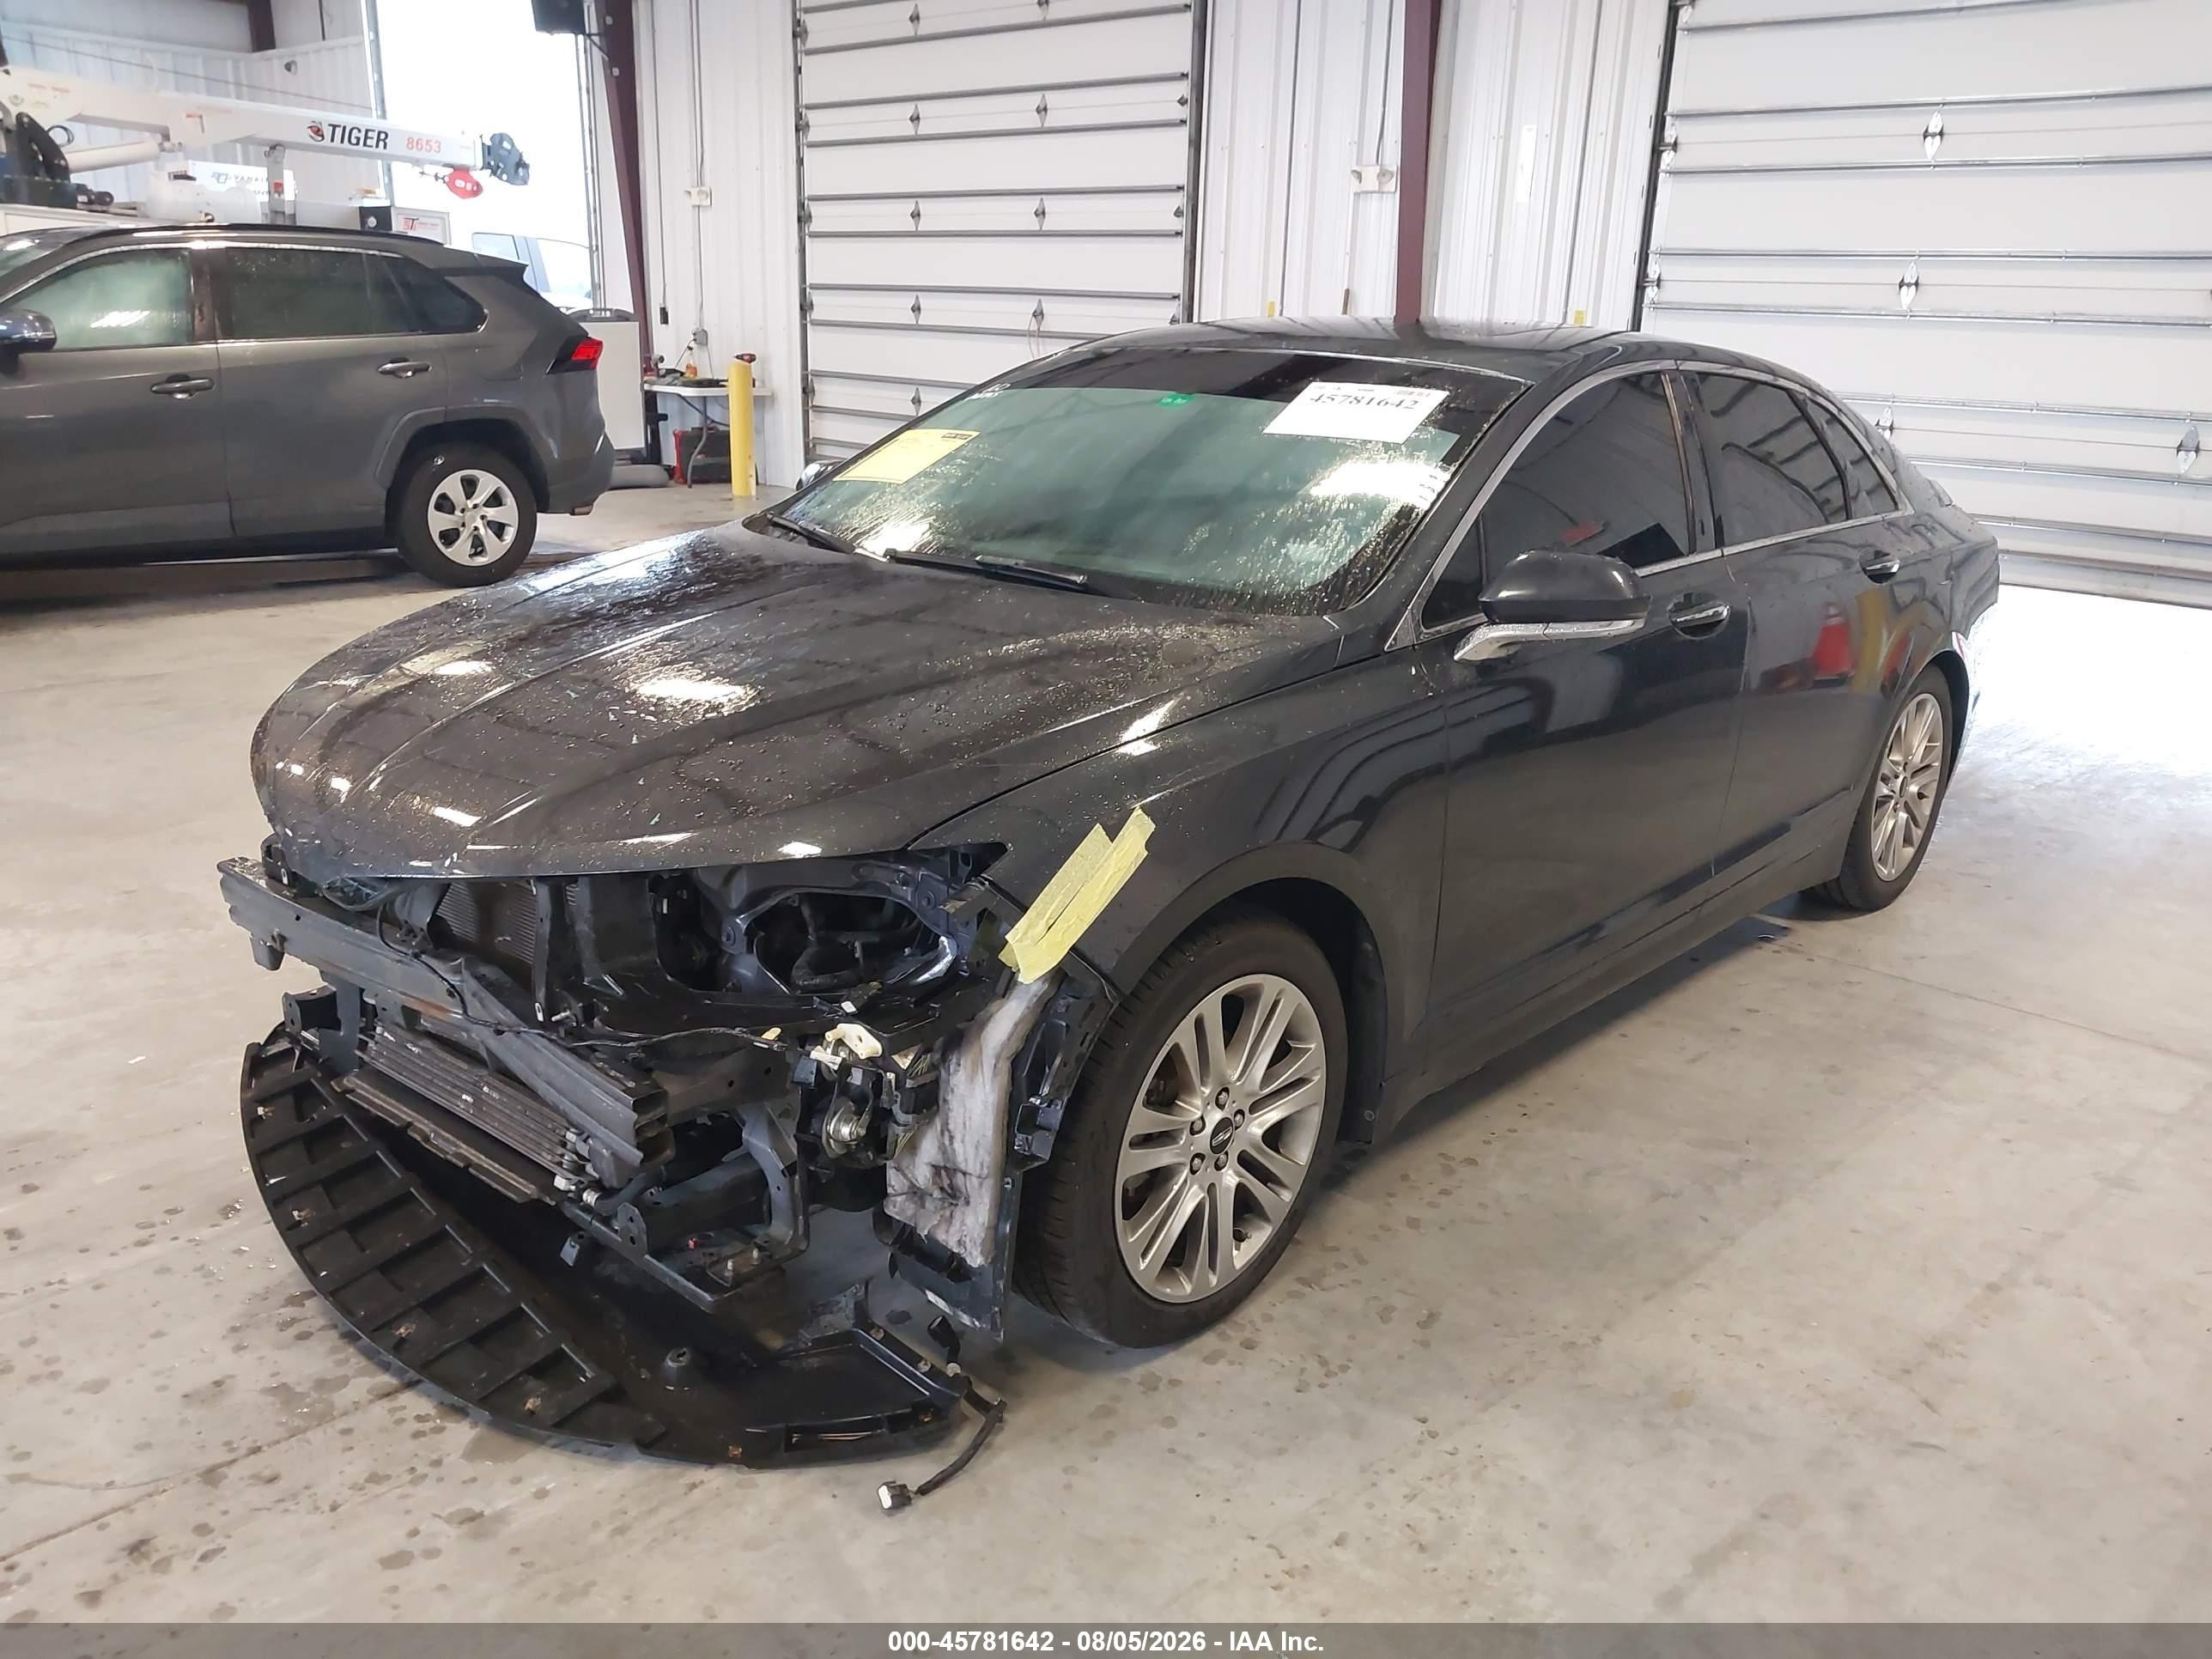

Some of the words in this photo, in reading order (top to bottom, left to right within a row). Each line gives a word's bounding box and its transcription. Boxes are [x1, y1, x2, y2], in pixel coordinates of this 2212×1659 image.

[327, 123, 389, 150] TIGER
[405, 136, 442, 154] 8653
[1309, 392, 1419, 410] 45781642
